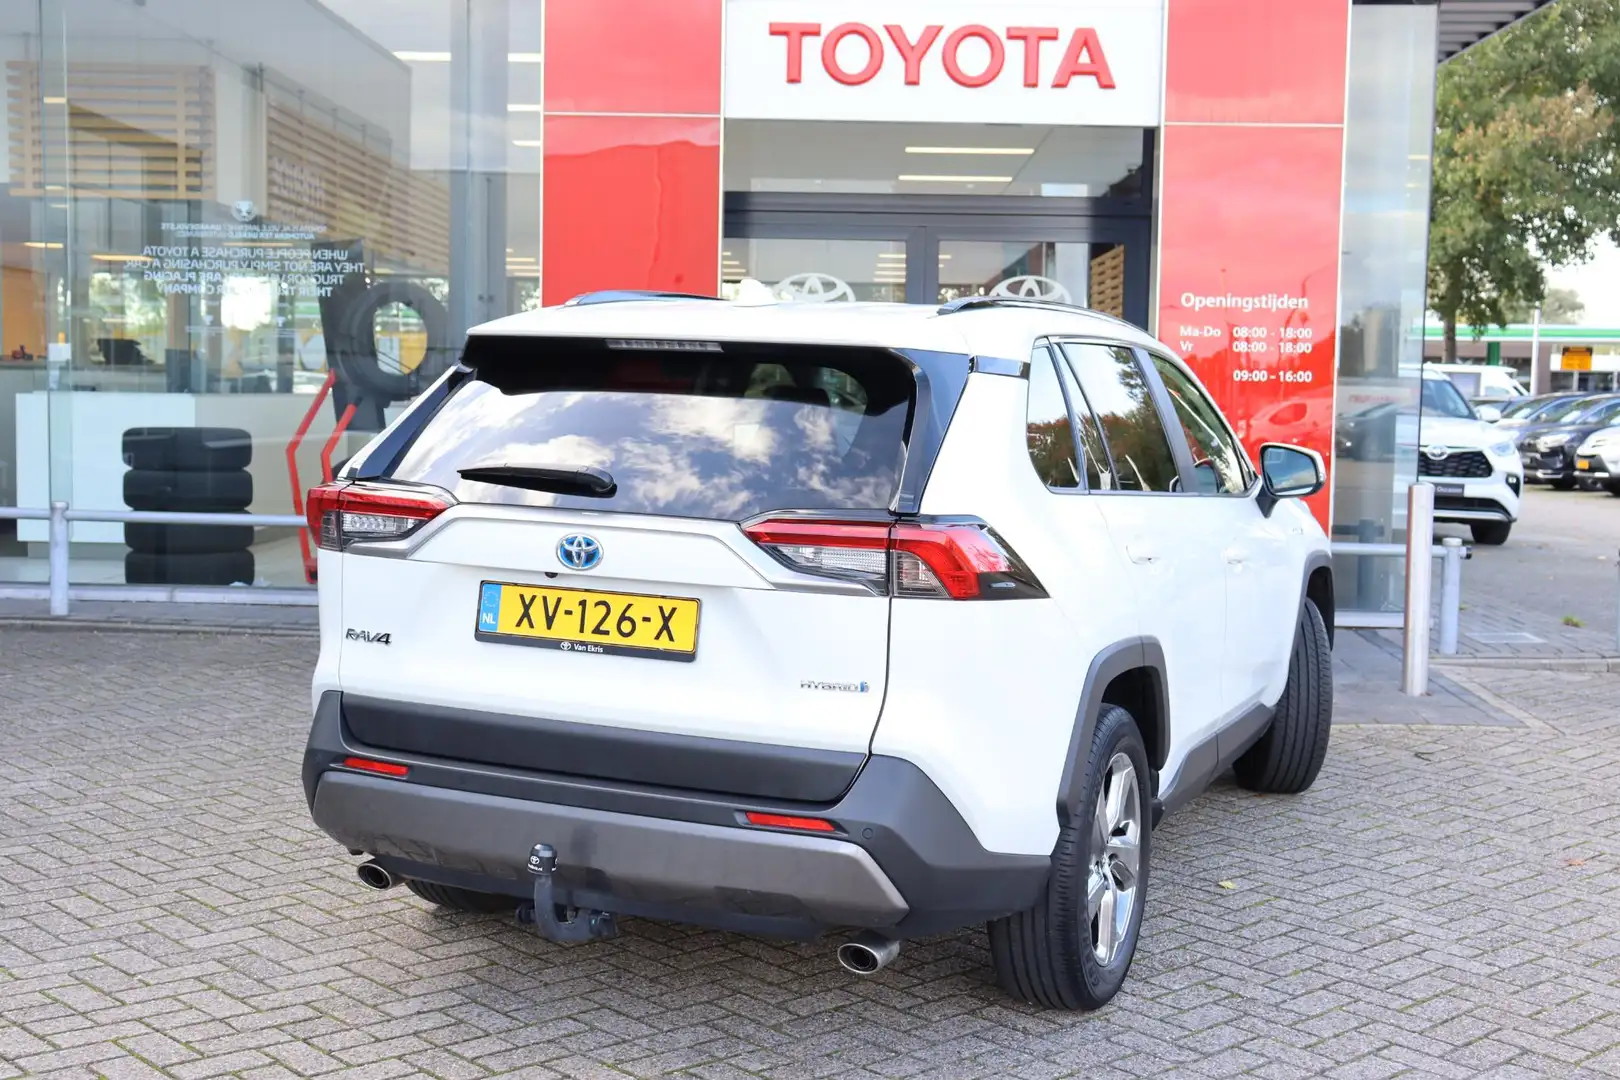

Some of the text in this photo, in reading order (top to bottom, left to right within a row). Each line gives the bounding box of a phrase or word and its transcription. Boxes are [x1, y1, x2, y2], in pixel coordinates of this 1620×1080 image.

[768, 21, 1116, 90] TOYOTA
[1180, 292, 1309, 312] Openingstijden
[1179, 325, 1222, 337] Ma-Do
[1232, 326, 1268, 338] 08:00
[1280, 327, 1313, 339] 18:00
[1179, 340, 1195, 352] Vr
[1232, 341, 1267, 353] 08:00
[1279, 341, 1313, 354] 18:00
[1232, 369, 1268, 382] 09:00
[1278, 370, 1313, 383] 16:00
[481, 612, 497, 625] NL
[514, 593, 678, 643] XV-126-X
[345, 628, 392, 645] RAV4
[573, 643, 604, 653] Van Ekris
[800, 680, 859, 692] HYBRID
